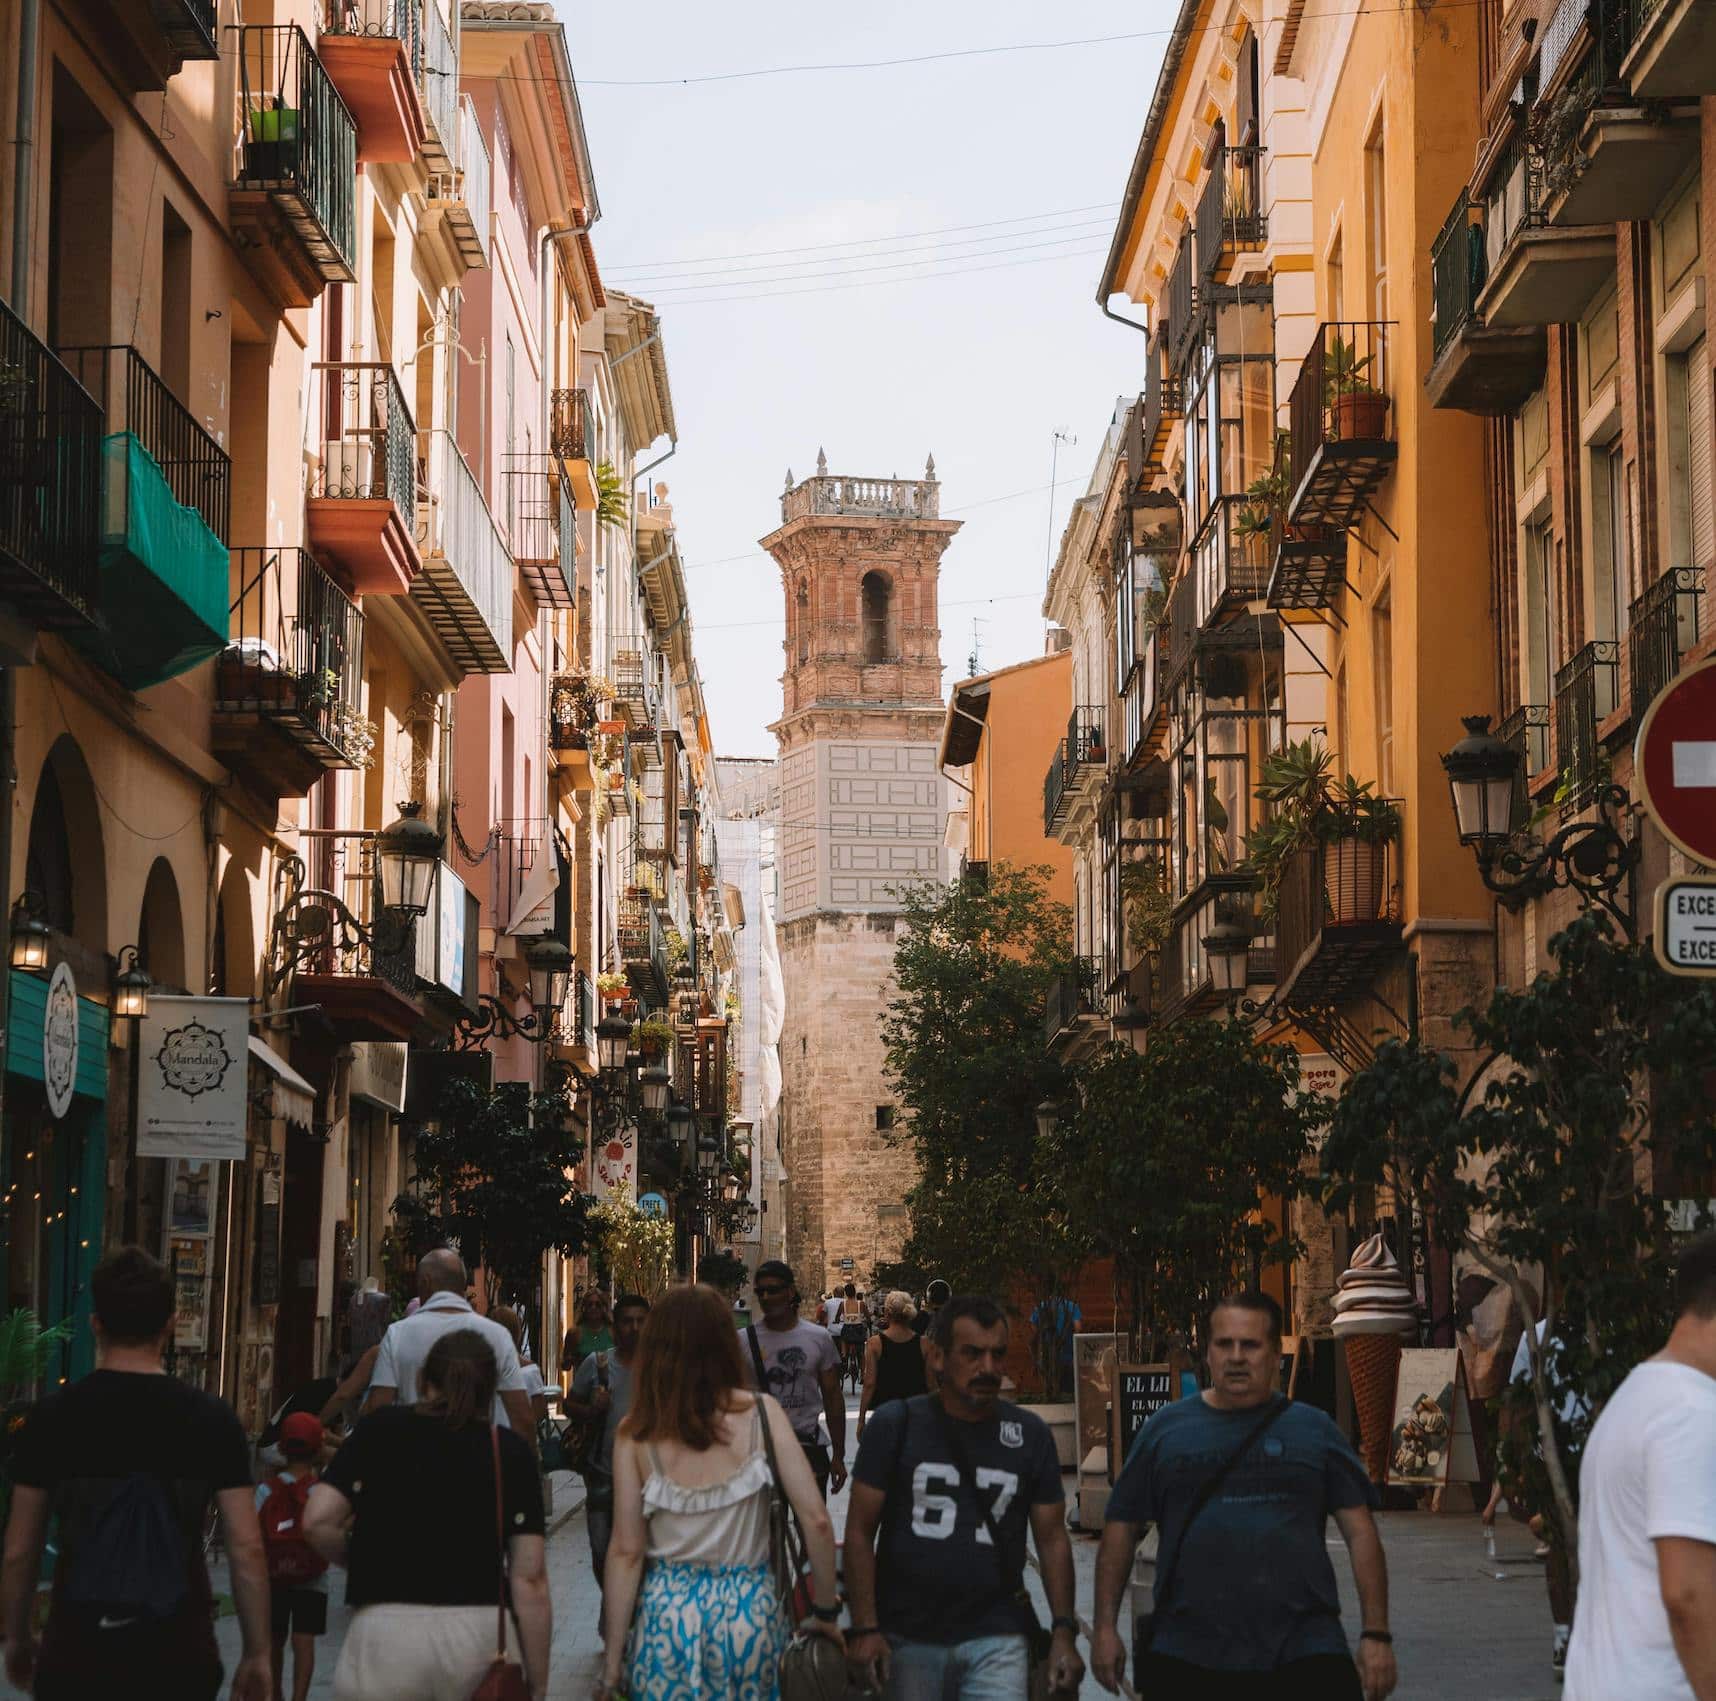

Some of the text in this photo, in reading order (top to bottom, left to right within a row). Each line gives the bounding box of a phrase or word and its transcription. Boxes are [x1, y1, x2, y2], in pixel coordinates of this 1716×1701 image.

[168, 1051, 219, 1066] Mandala
[1126, 1376, 1145, 1393] EL
[911, 1461, 1019, 1546] 67
